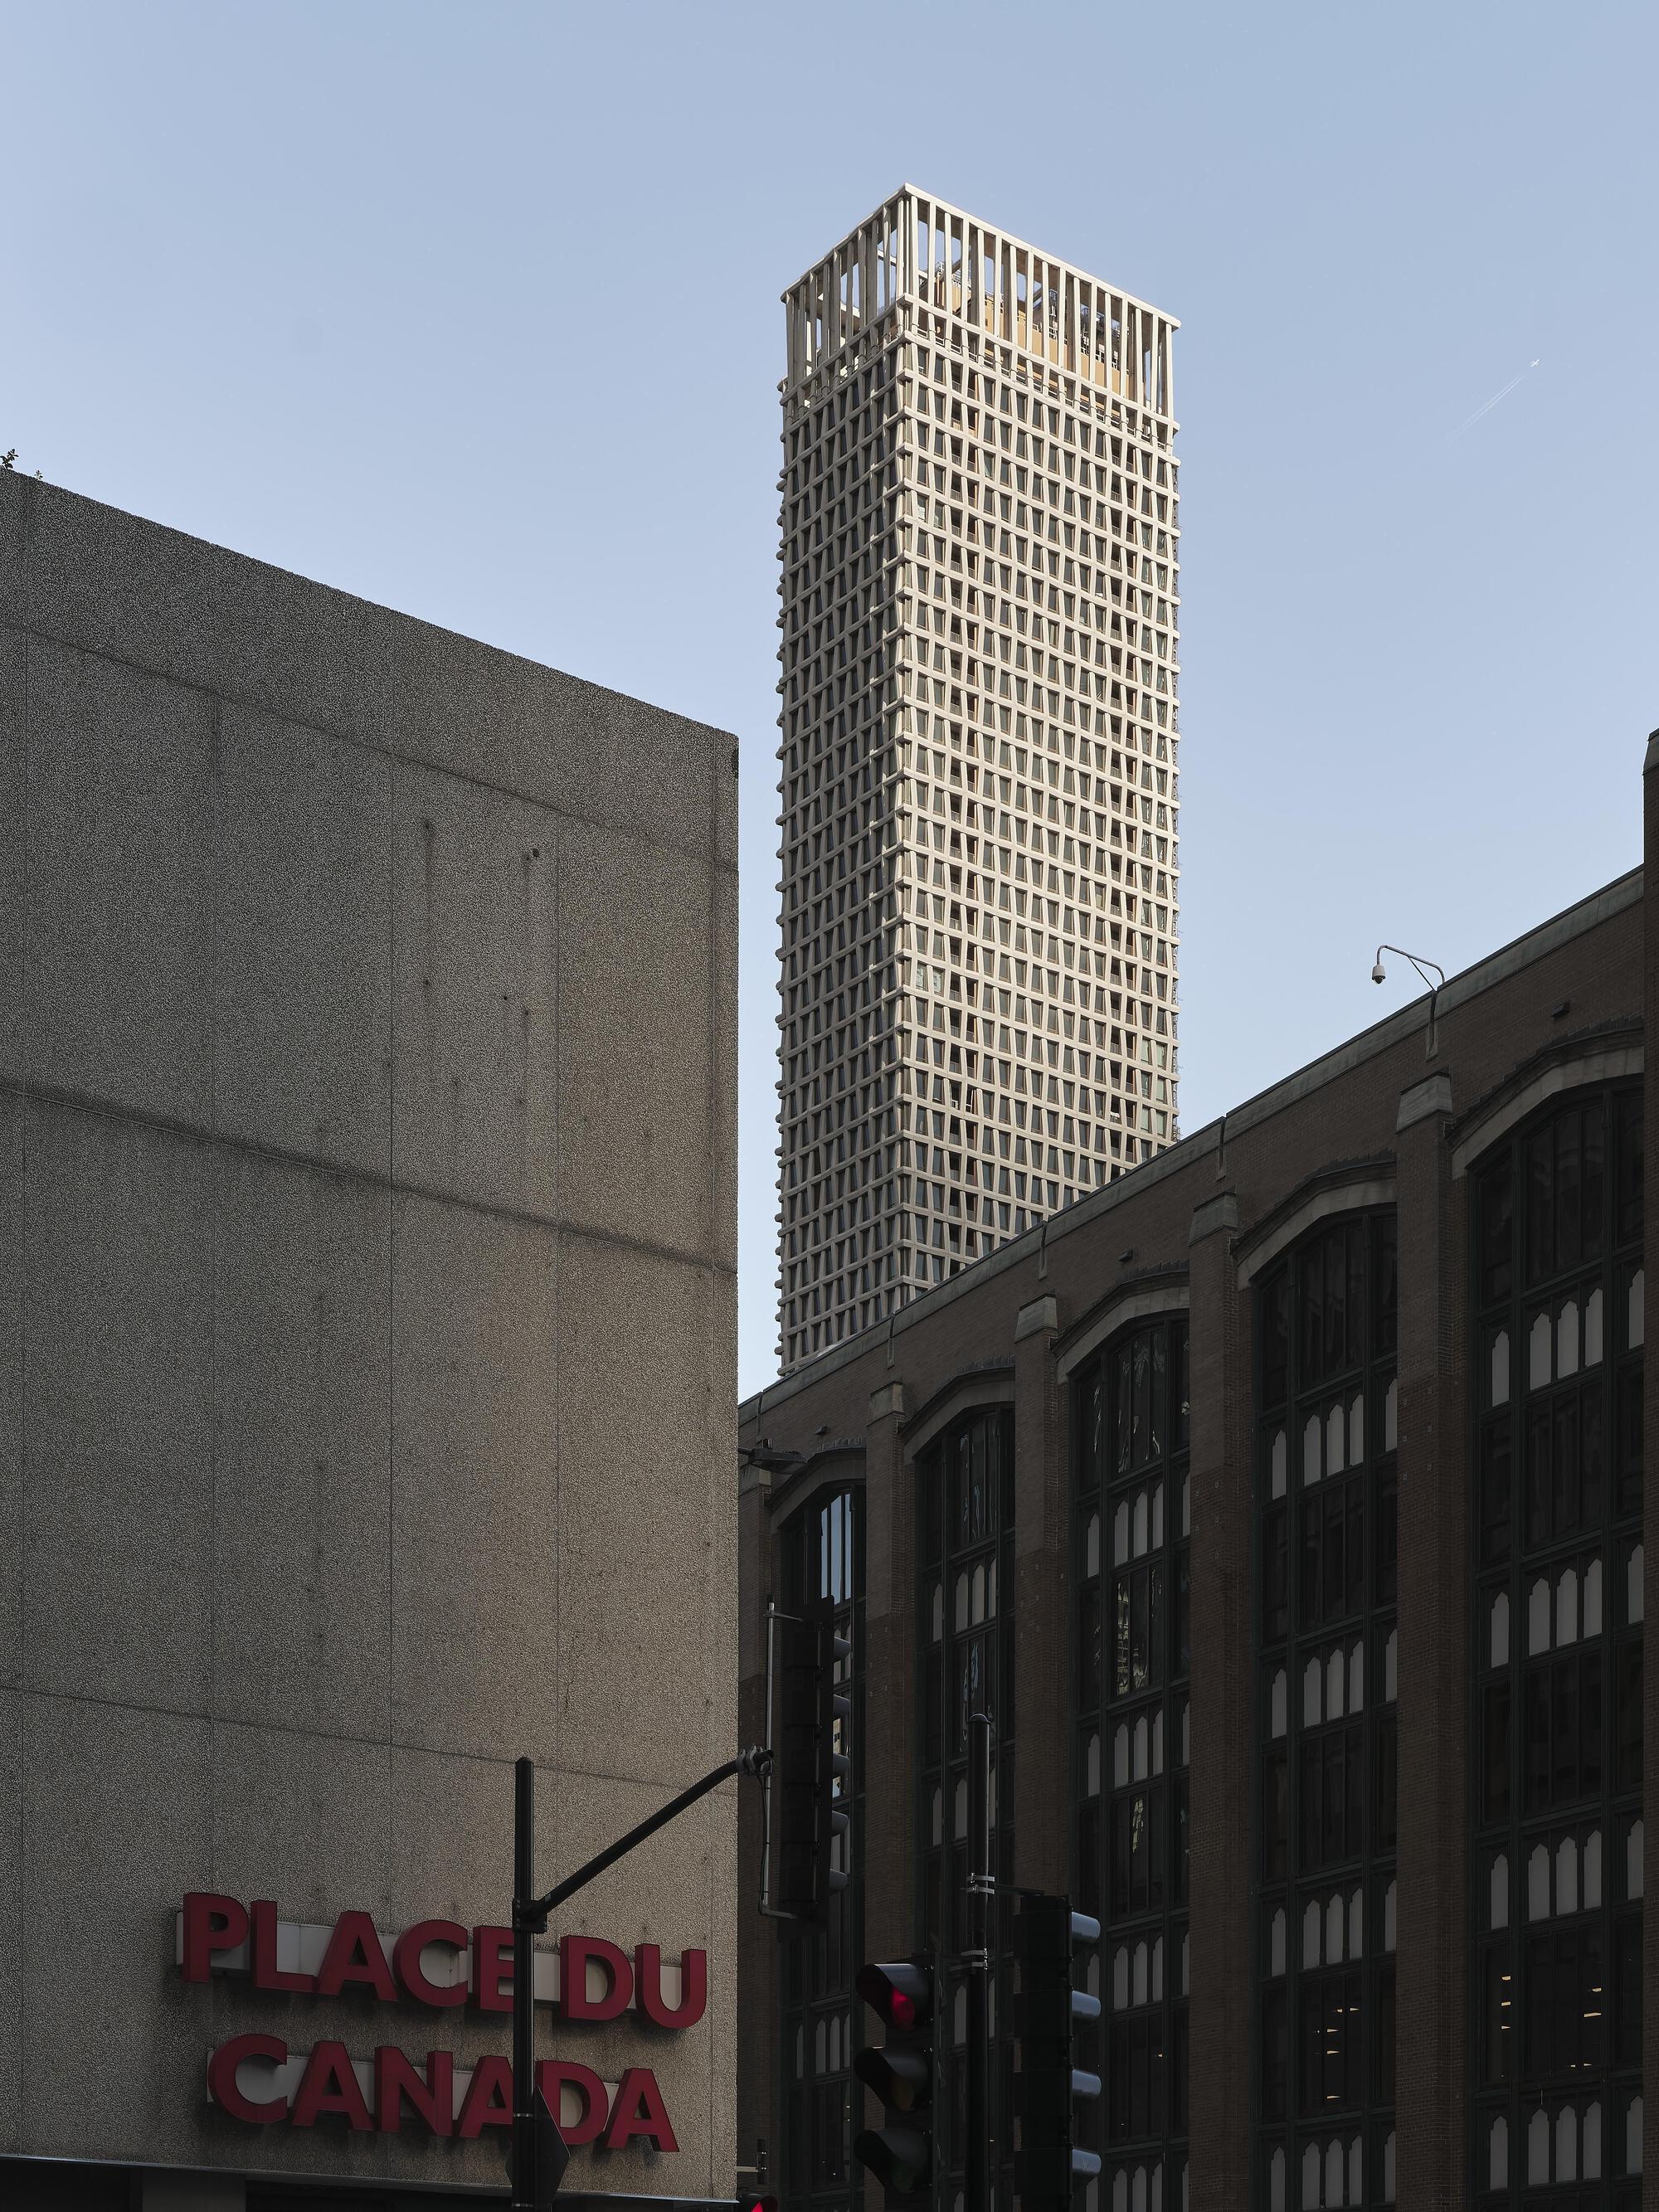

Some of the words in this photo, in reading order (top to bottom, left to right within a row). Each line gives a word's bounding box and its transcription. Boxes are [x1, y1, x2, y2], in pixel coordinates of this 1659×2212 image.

[182, 1892, 514, 2012] PLACE
[560, 1934, 708, 2029] DU
[208, 2033, 679, 2152] CANADA
